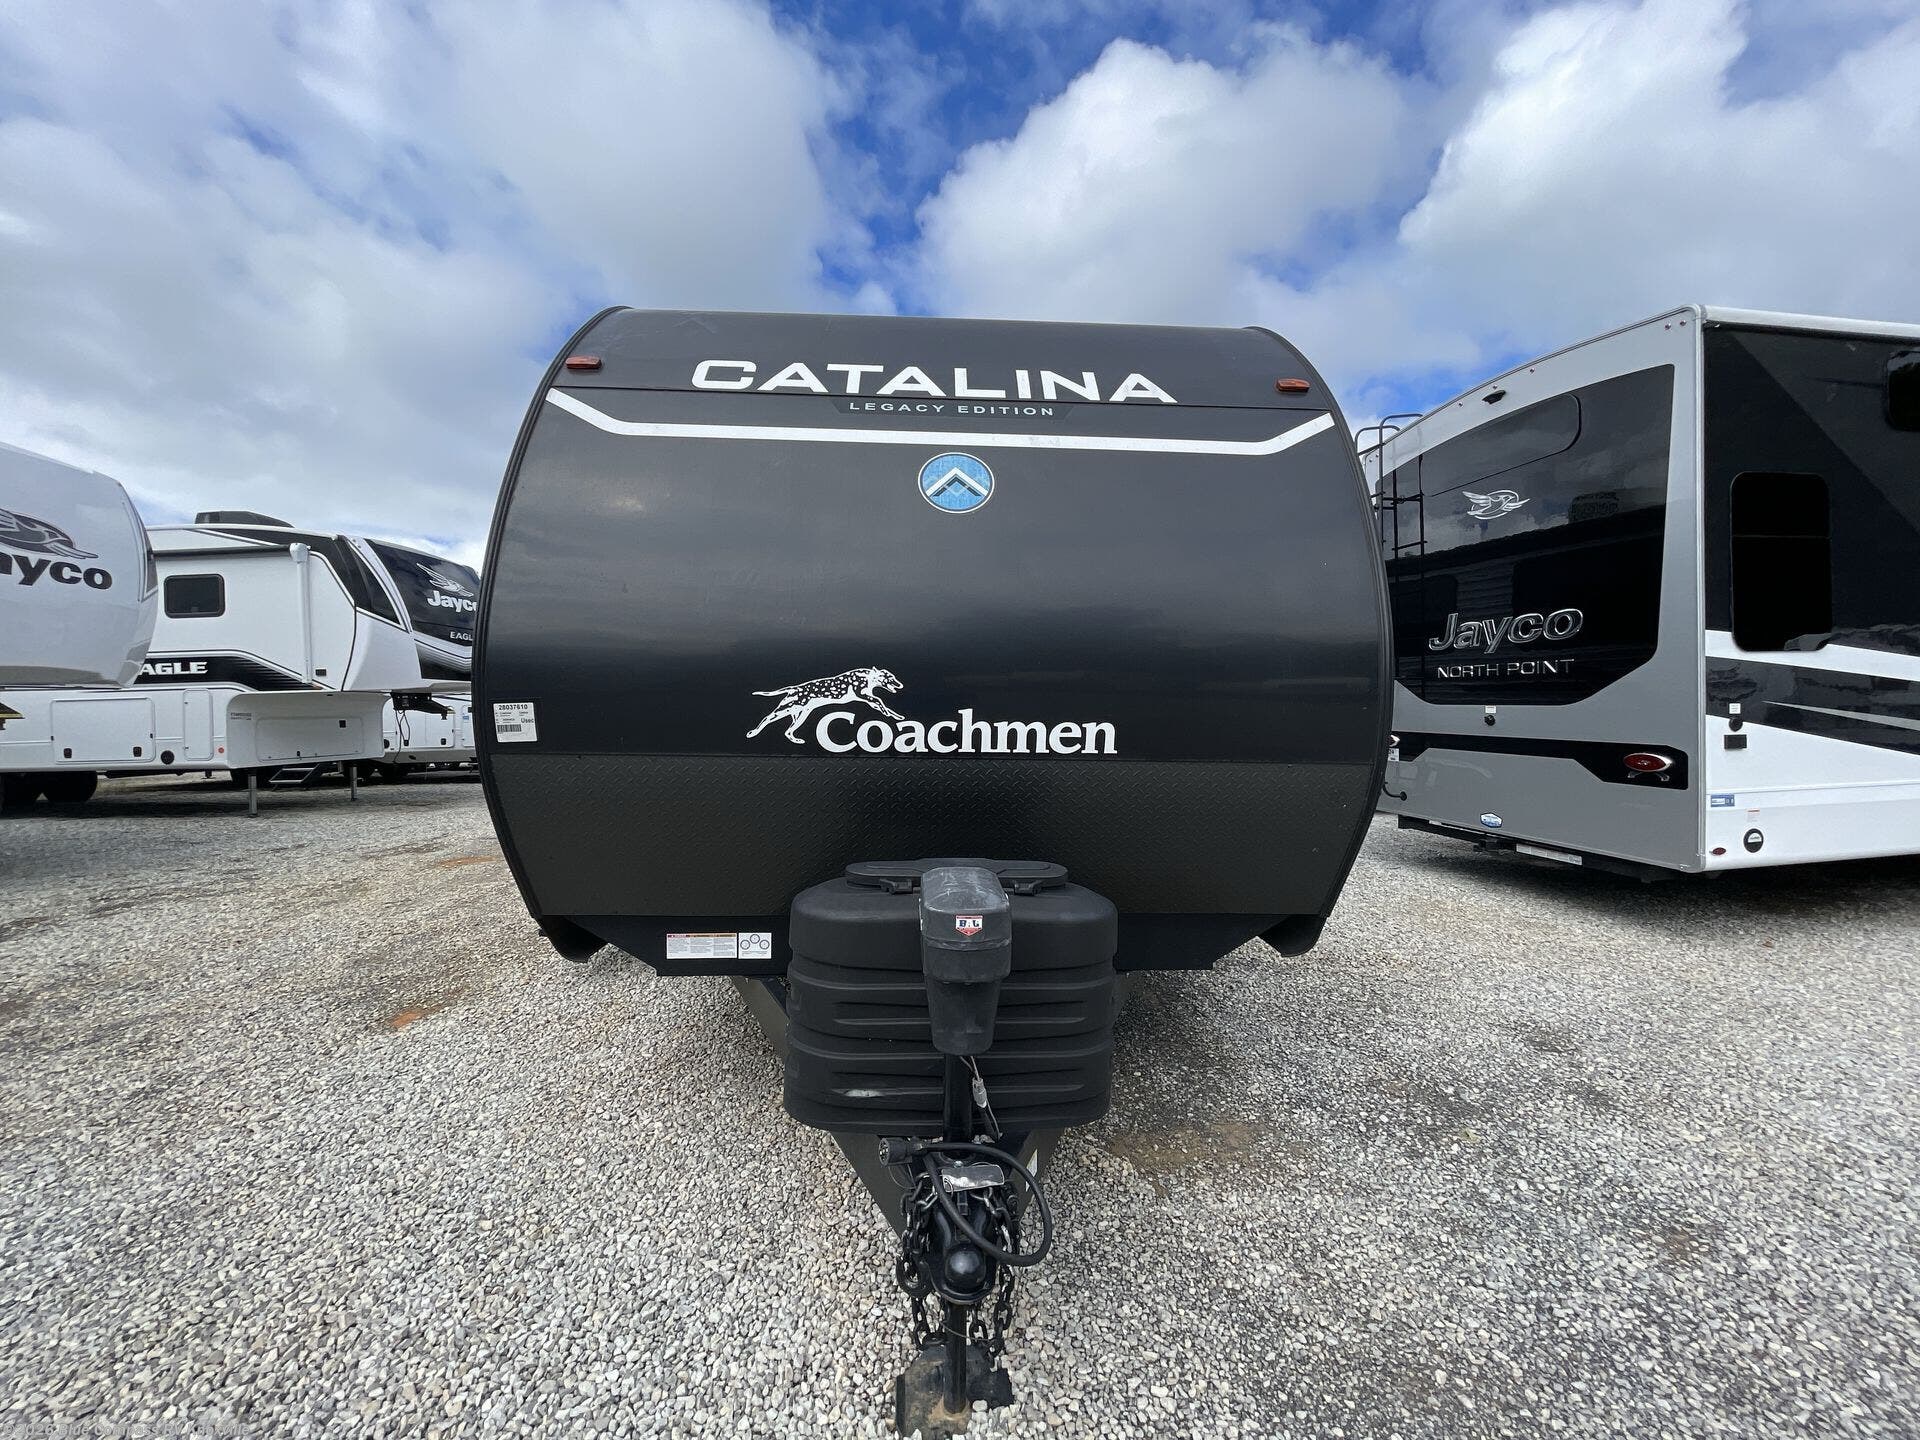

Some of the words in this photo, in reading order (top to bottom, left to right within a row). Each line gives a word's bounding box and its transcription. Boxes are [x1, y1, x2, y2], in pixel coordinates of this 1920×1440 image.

[691, 359, 1178, 403] CATALINA
[849, 402, 945, 413] LEGACY
[957, 405, 1055, 416] EDITION
[0, 551, 113, 590] yco
[449, 631, 474, 641] EAGL
[1428, 608, 1584, 654] Jayco
[138, 661, 208, 676] AGLE
[1437, 663, 1500, 679] NORTH
[1507, 658, 1575, 676] POINT
[815, 708, 1119, 754] Coachmen
